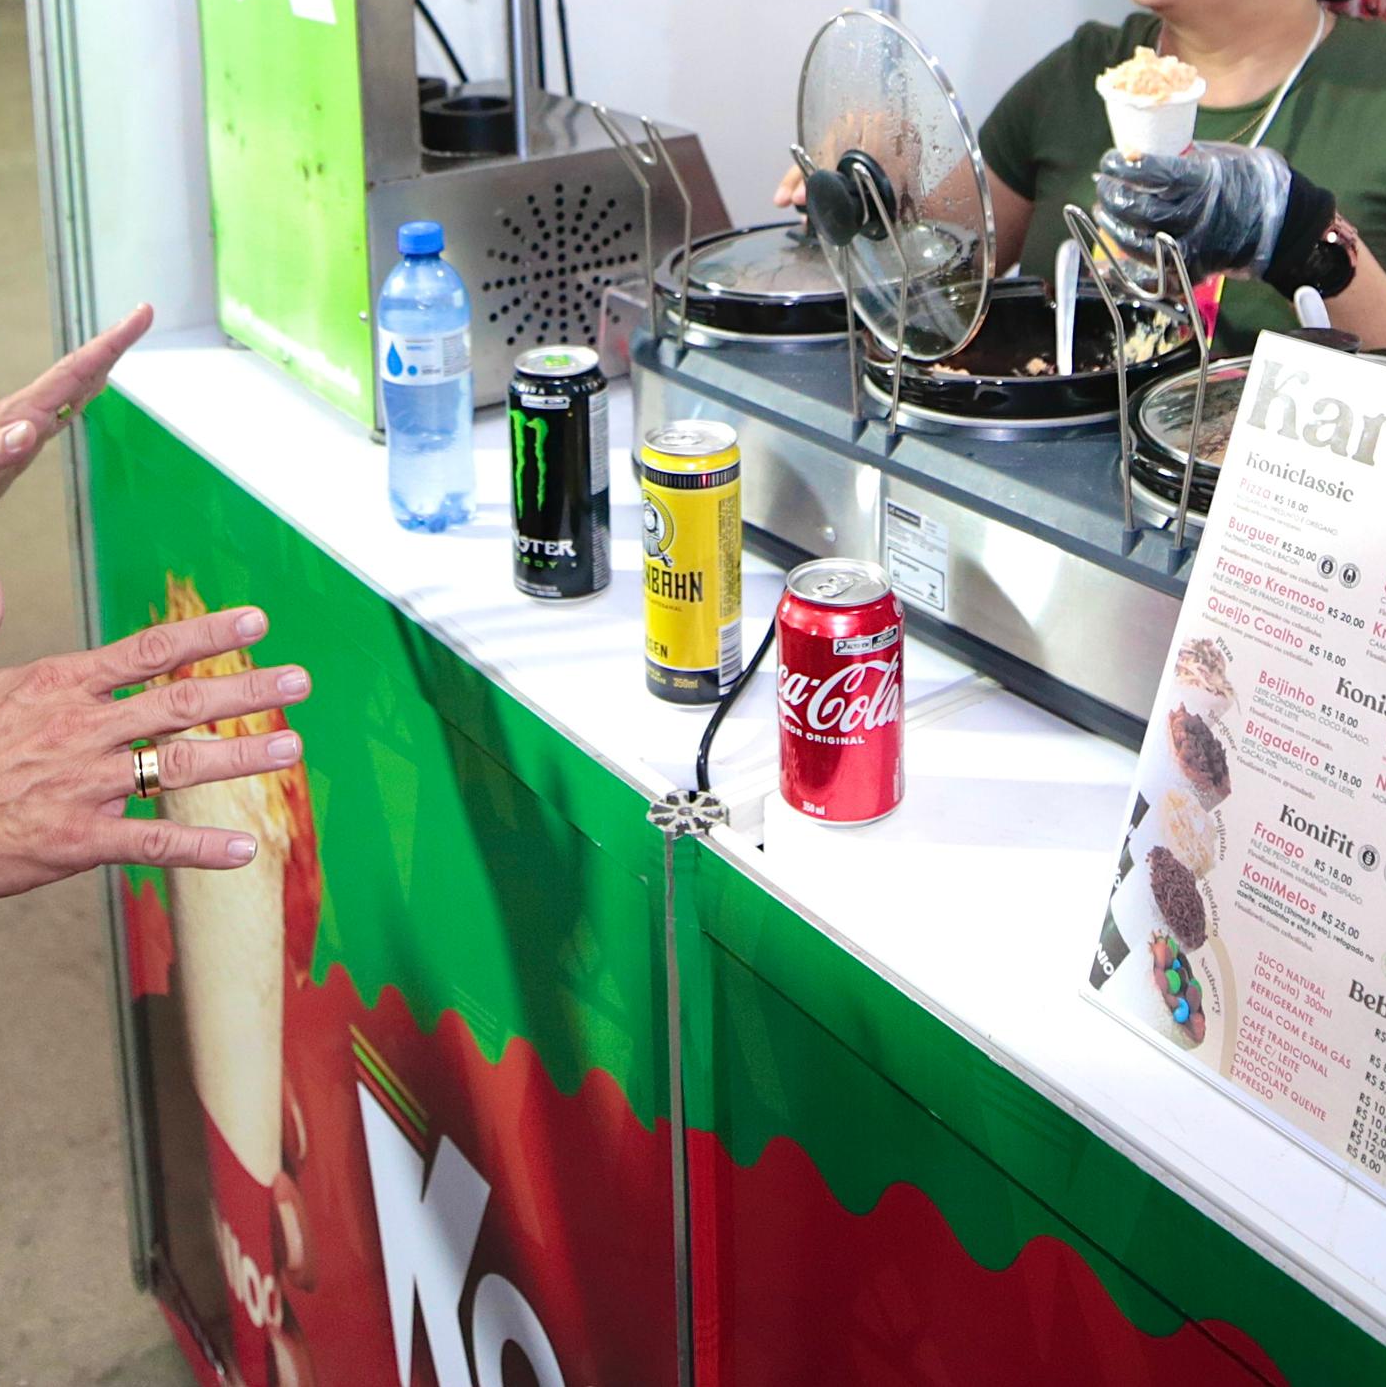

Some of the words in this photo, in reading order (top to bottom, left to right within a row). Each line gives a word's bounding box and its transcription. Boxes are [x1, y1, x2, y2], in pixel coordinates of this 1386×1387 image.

[1239, 477, 1271, 500] Pizza
[1274, 494, 1285, 505] R$
[1245, 451, 1354, 503] Koniclassic
[1228, 516, 1280, 547] Burguer
[1282, 541, 1293, 553] R$
[1294, 546, 1317, 562] 20,00
[1216, 557, 1262, 586] Frango
[1265, 574, 1325, 613] Kremoso
[1327, 607, 1338, 619] R$
[1340, 611, 1365, 629] 20,00
[1207, 596, 1250, 626] Queijo
[1254, 616, 1304, 649] Coalho
[1309, 645, 1320, 656] R$
[1322, 648, 1347, 667] 18,00
[673, 677, 699, 689] 350ml
[1258, 670, 1315, 706] Beijinho
[1321, 705, 1333, 717] R$
[1335, 710, 1358, 728] 18,00
[806, 732, 866, 746] ORIGINAL
[1245, 720, 1320, 766] Brigadeiro
[1324, 762, 1335, 775] R$
[1338, 769, 1362, 788] 18,00
[1254, 821, 1304, 859] Frango
[1314, 859, 1325, 872] R$
[1328, 865, 1352, 886] 18,00
[1279, 804, 1355, 859] KoniFit
[1199, 876, 1219, 937] rigadeiro
[1242, 863, 1317, 915] KoniMelos
[1321, 911, 1333, 925] R$
[1334, 918, 1360, 940] 25,00
[1257, 951, 1284, 973] SUCO
[1286, 968, 1325, 999] NATURAL
[1272, 974, 1300, 999] Fruta)
[1304, 994, 1333, 1018] 300ml
[1247, 995, 1273, 1020] ÁGUA
[1276, 1014, 1300, 1035] COM
[1308, 1035, 1329, 1055] SEM
[1330, 1047, 1351, 1069] GÁS
[1369, 1054, 1381, 1068] R$
[1251, 980, 1315, 1026] REFRIGERANTE
[1375, 1028, 1386, 1042] R$
[1236, 1041, 1293, 1083] CAPUCCINO
[1355, 1106, 1368, 1120] R$
[1239, 1028, 1263, 1048] CAFÉ
[1264, 1043, 1276, 1056] C/
[1278, 1051, 1301, 1073] LEITE
[1359, 1092, 1371, 1107] R$
[1242, 1015, 1266, 1035] CAFÉ
[1267, 1028, 1329, 1078] TRADICIONAL
[1365, 1071, 1377, 1086] R$
[1230, 1065, 1274, 1100] EXPRESSO
[1350, 1131, 1362, 1145] R$
[1233, 1053, 1289, 1095] CHOCOLATE
[1290, 1091, 1327, 1122] QUENTE
[1353, 1119, 1364, 1133] R$
[1346, 1144, 1358, 1159] R$
[1360, 1153, 1381, 1174] 8,00
